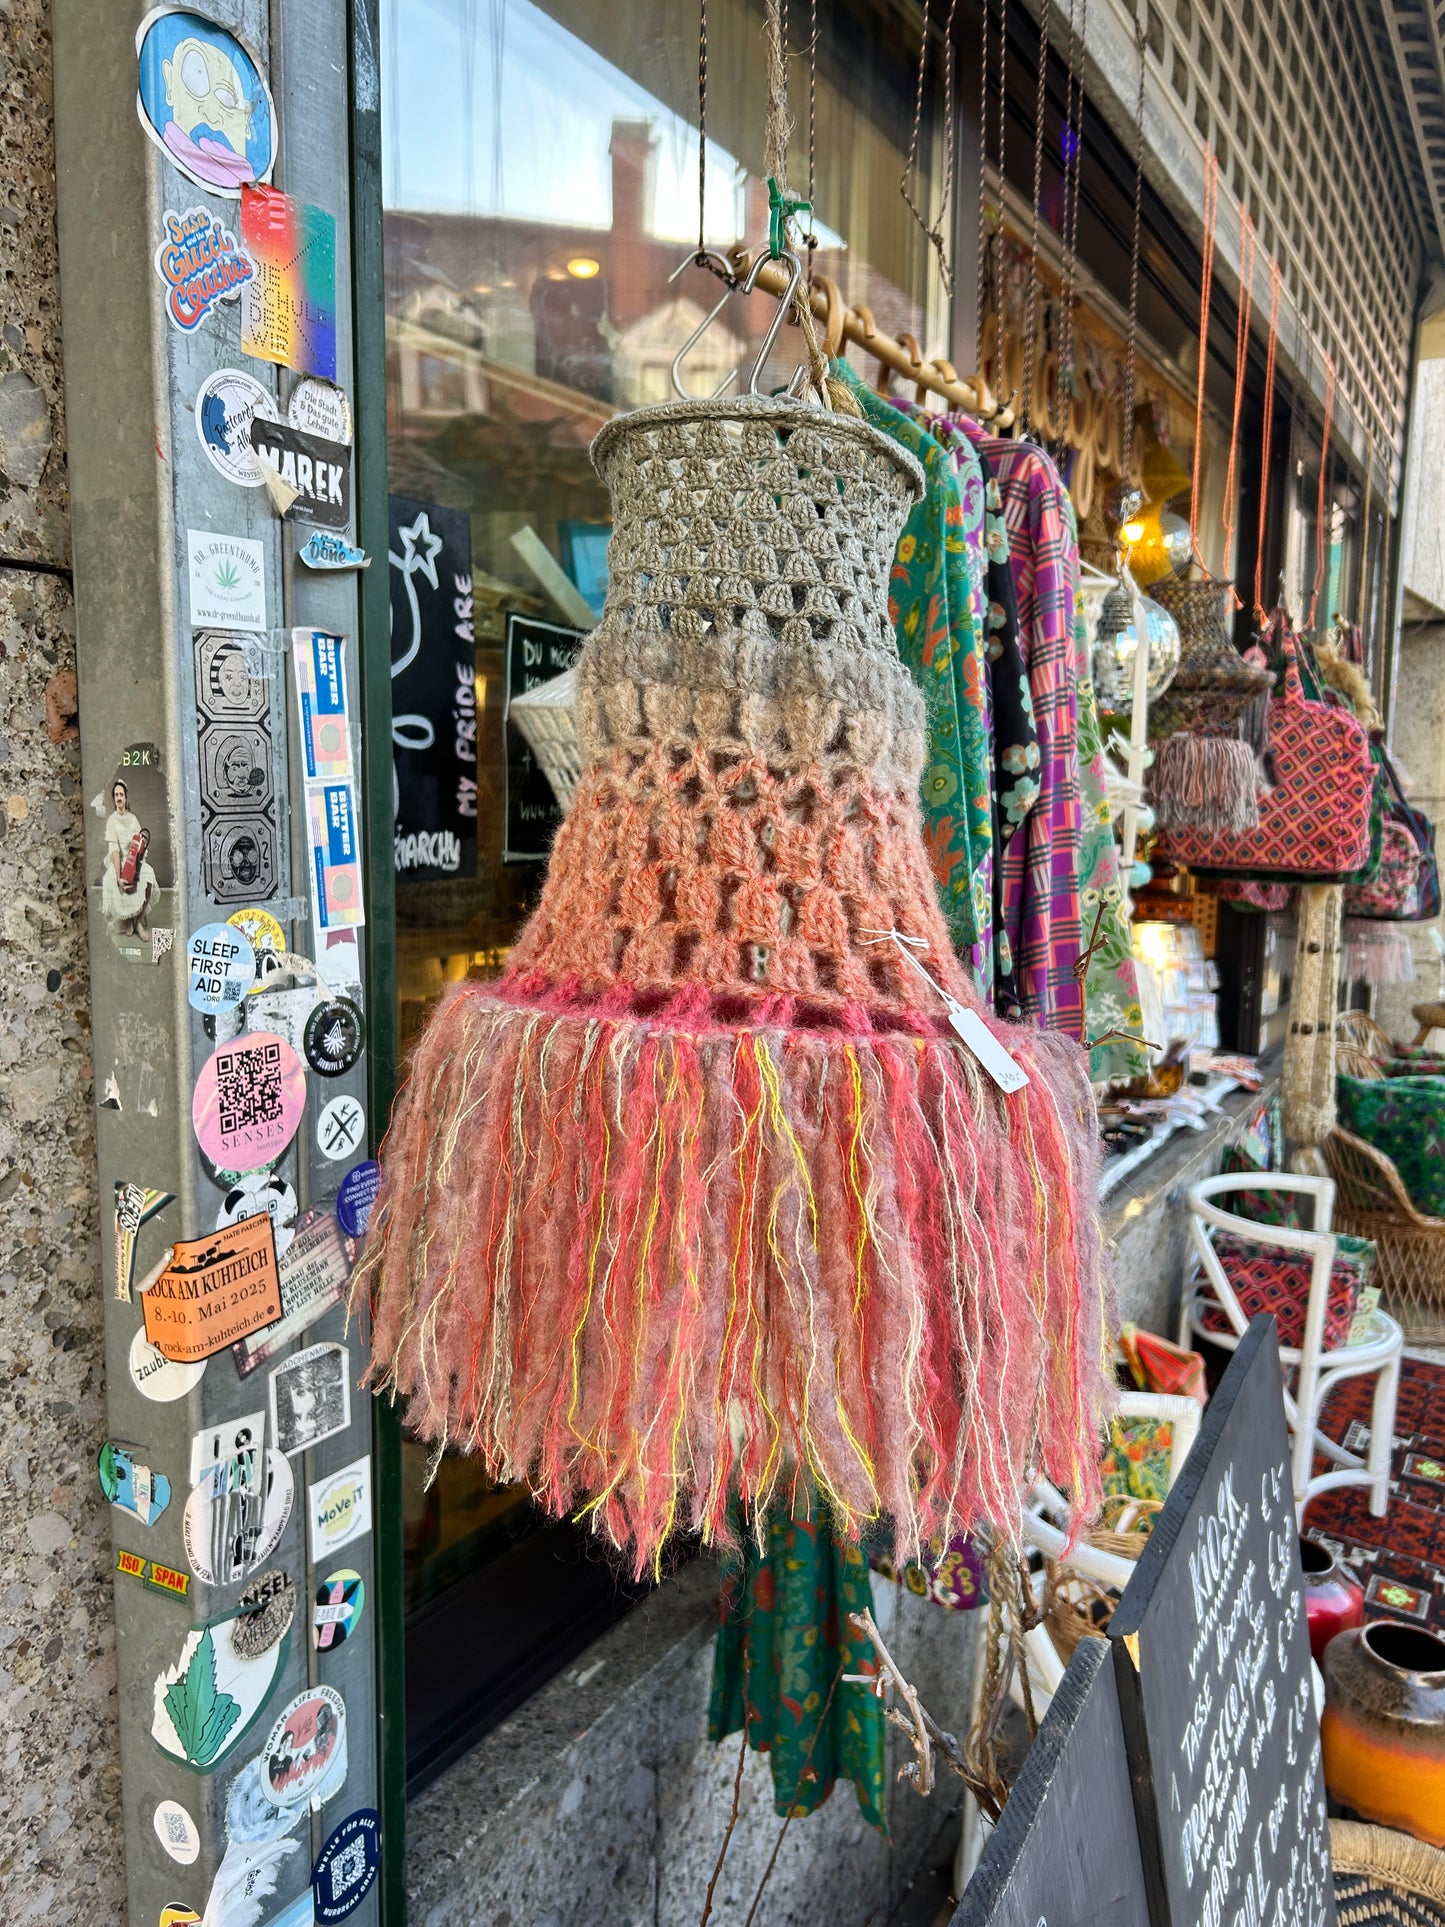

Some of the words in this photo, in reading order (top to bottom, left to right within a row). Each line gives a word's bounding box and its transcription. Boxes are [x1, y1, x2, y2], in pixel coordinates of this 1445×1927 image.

[167, 213, 209, 243] Sasa
[162, 223, 233, 285] Gucci
[305, 391, 317, 404] Die
[319, 399, 337, 416] Stadt
[307, 404, 320, 418] Das
[322, 415, 339, 429] gute
[307, 416, 330, 435] Leben
[258, 444, 343, 506] MAREK
[454, 572, 476, 644] ARE
[317, 638, 328, 676] BAR
[327, 638, 339, 706] BUTTER
[523, 639, 543, 667] DU
[123, 751, 150, 766] B2K
[330, 791, 340, 829] BAR
[458, 776, 479, 818] MY
[338, 790, 351, 856] BUTTER
[191, 958, 231, 977] FIRST
[193, 939, 239, 959] SLEEP
[195, 977, 222, 994] AID
[222, 1122, 284, 1150] SENSES
[344, 1188, 370, 1203] CONNECT
[223, 1228, 241, 1242] HATE
[241, 1216, 269, 1234] FASCISM
[178, 1280, 200, 1301] AM
[201, 1247, 269, 1296] KUHTEICH
[198, 1296, 227, 1321] Mai
[230, 1279, 267, 1305] 2025
[164, 1310, 265, 1354] rock-am-kuhteich.de
[121, 1554, 139, 1573] ISO
[155, 1567, 184, 1591] SPAN
[263, 1714, 287, 1764] WOMAN
[294, 1692, 312, 1708] LIFE
[1181, 1671, 1213, 1773] TASSE
[1182, 1683, 1239, 1889] PROSECCO
[318, 1836, 340, 1873] WELLE
[342, 1820, 358, 1837] FÜR
[359, 1818, 376, 1830] ALLE
[360, 1865, 376, 1893] GRAZ
